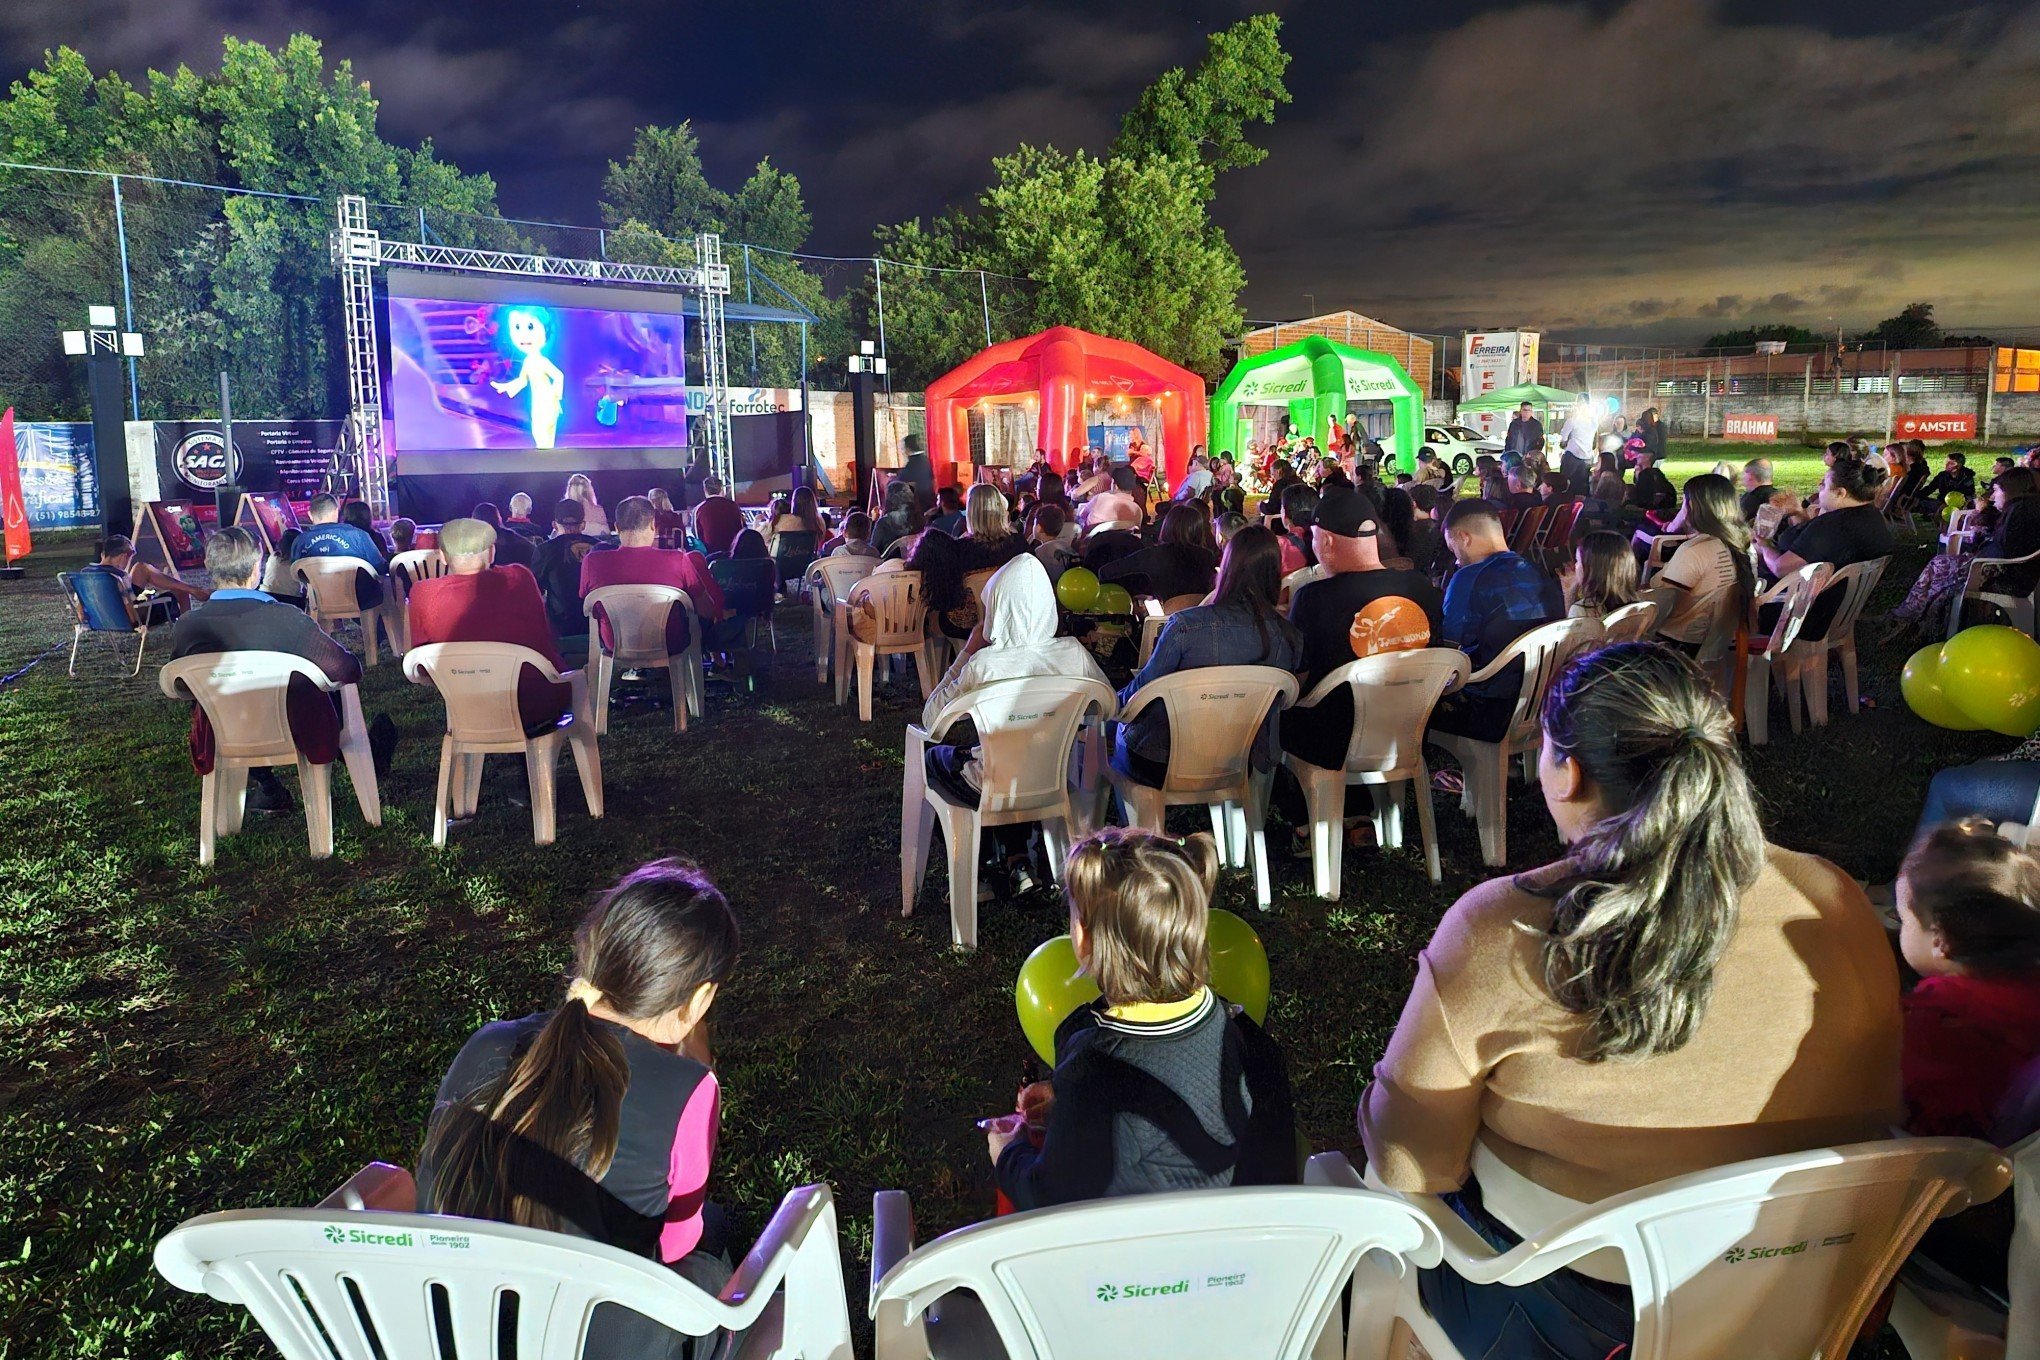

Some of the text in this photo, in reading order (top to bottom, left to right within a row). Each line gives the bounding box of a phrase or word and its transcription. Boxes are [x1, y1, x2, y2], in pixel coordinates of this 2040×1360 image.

[1470, 337, 1510, 354] FERREIRA
[1260, 380, 1308, 394] Sicredi
[1361, 379, 1396, 391] Sicredi
[730, 400, 784, 413] forrotec
[1727, 420, 1775, 435] BRAHMA
[1919, 421, 1967, 432] AMSTEL
[35, 510, 55, 521] (51)
[311, 533, 350, 549] AMERICANO
[350, 1229, 470, 1247] Sicredi Pioneira
[1747, 1240, 1808, 1260] Sicredi
[1123, 1273, 1246, 1298] Sicredi Pioneira
